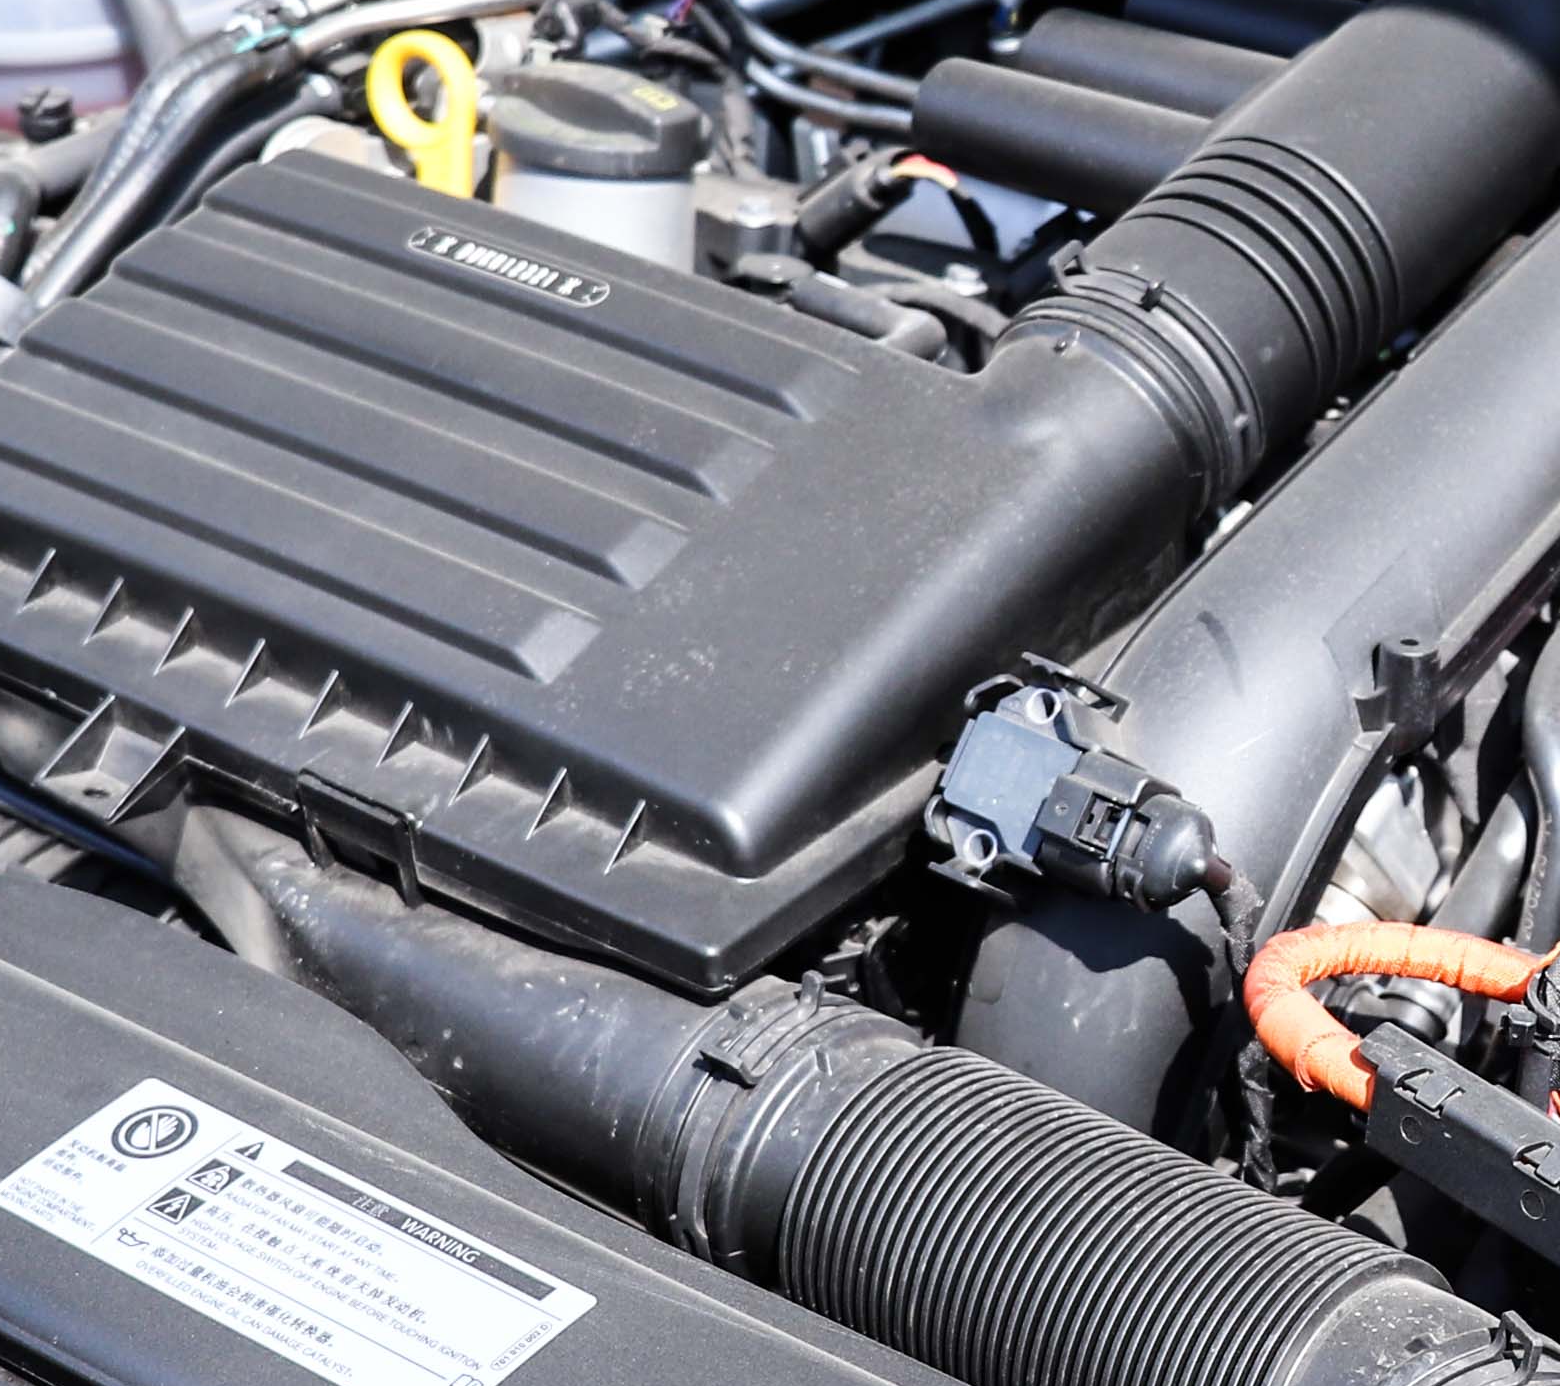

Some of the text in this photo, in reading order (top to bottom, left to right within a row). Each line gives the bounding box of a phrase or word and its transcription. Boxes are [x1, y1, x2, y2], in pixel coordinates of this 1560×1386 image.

[223, 1190, 270, 1217] RADIATOR
[307, 1233, 341, 1252] START
[350, 1255, 375, 1269] ANY
[352, 1196, 480, 1262] 注意 WARNING
[135, 1259, 192, 1292] OVERFILLED
[189, 1287, 226, 1311] ENGINE
[240, 1314, 263, 1330] CAN
[260, 1325, 304, 1351] DAMAGE
[213, 1228, 258, 1255] VOLTAGE
[255, 1250, 294, 1273] SWITCH
[291, 1269, 314, 1282] OFF
[311, 1279, 350, 1302] ENGINE
[347, 1297, 389, 1323] BEFORE
[388, 1317, 439, 1348] TOUCHING
[436, 1344, 483, 1371] IGNITION
